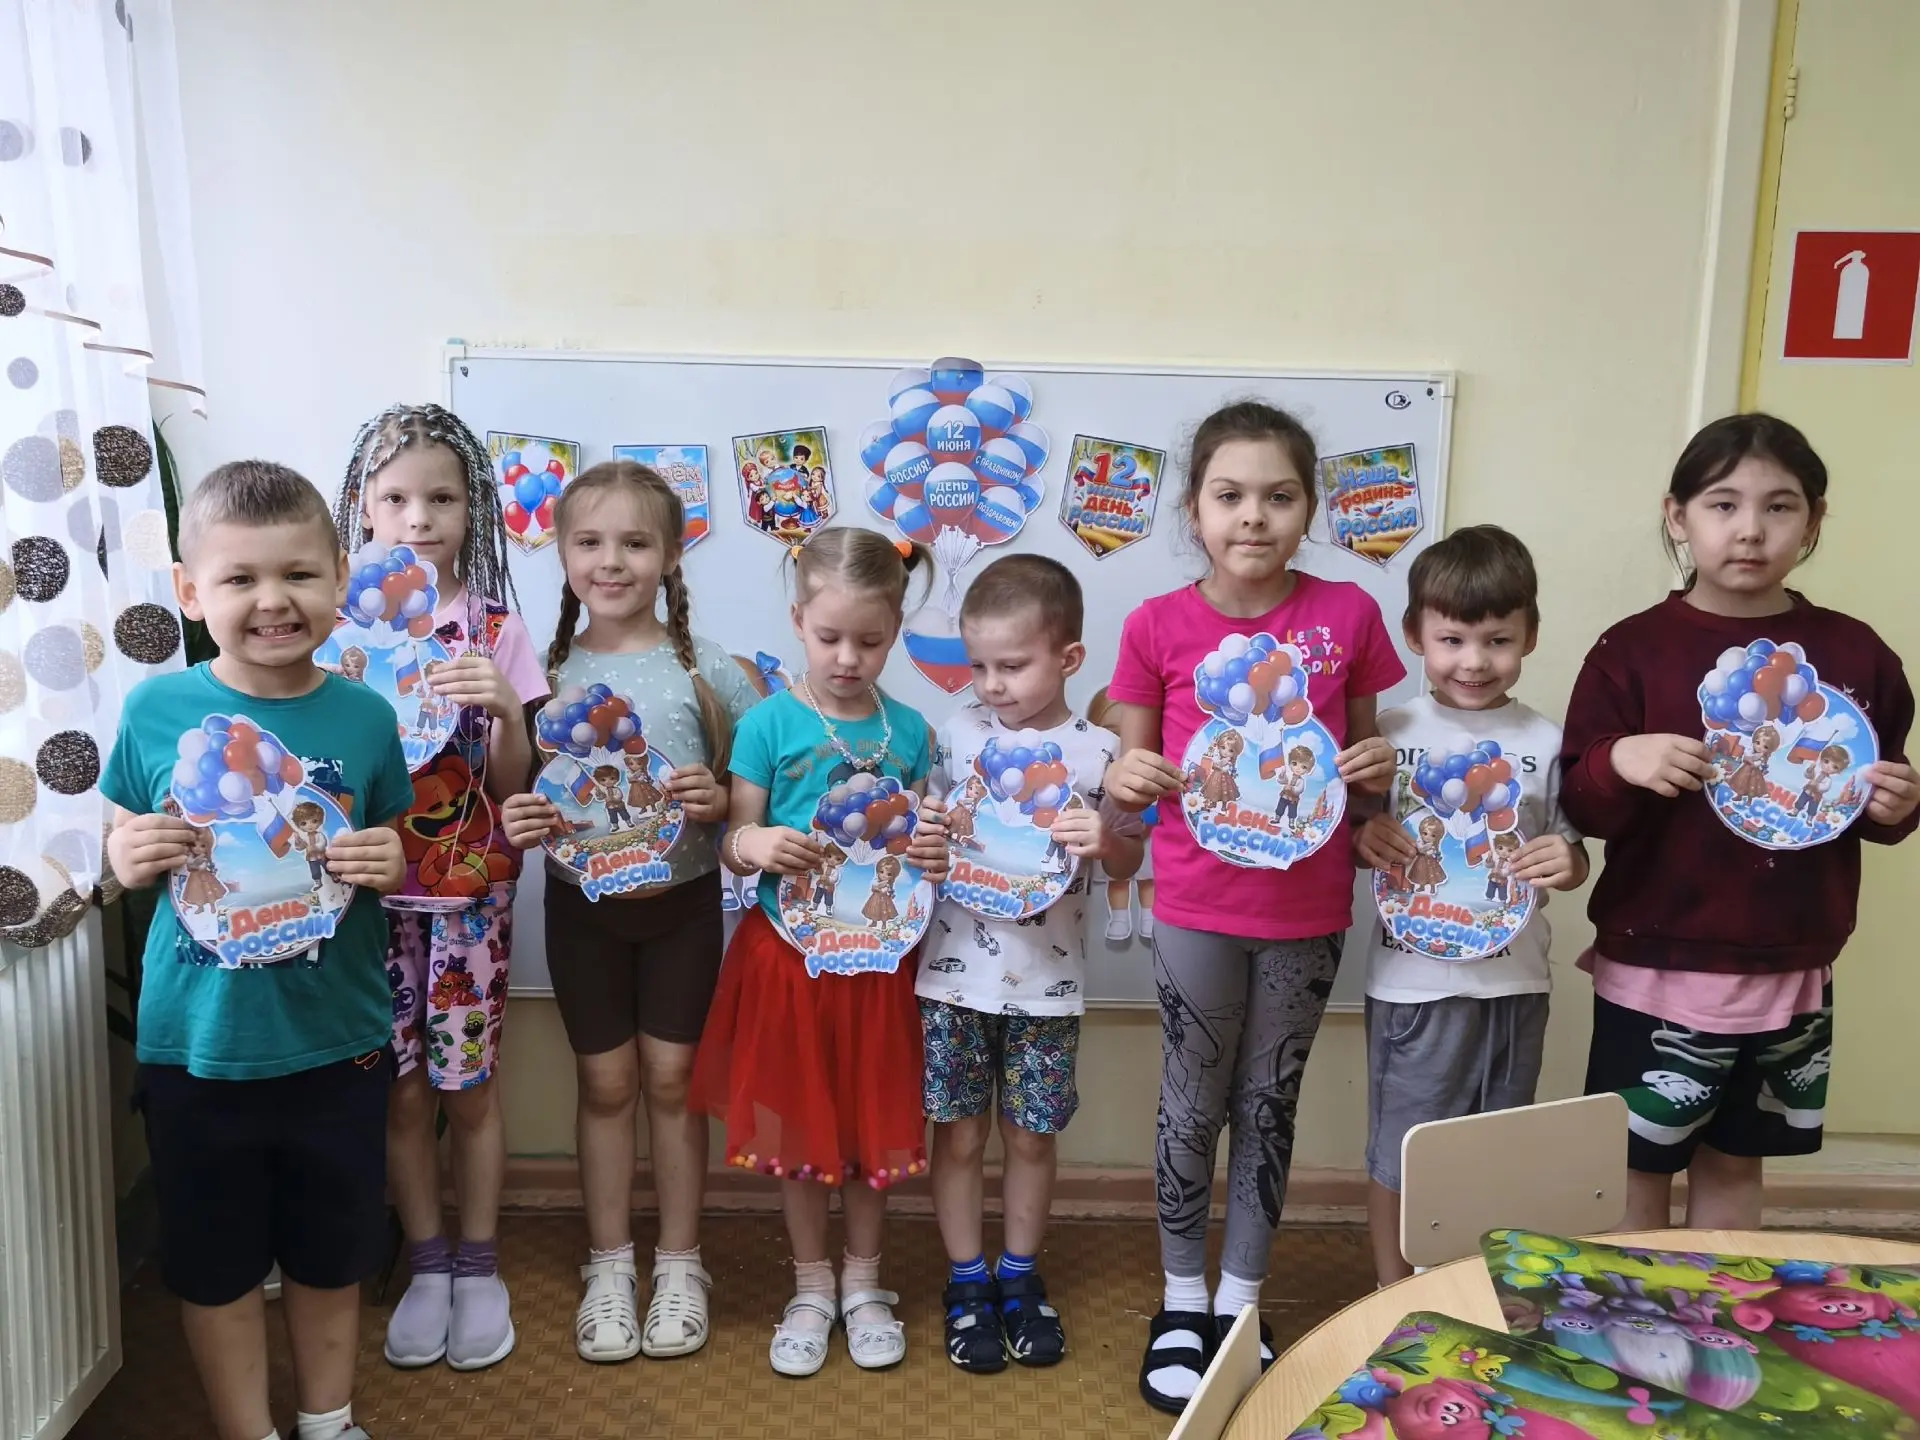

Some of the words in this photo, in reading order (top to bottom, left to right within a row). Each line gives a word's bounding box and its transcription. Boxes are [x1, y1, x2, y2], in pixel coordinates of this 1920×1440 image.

[943, 420, 965, 440] 12
[936, 439, 971, 452] ИЮНЯ
[889, 457, 932, 484] РОССИЯ!
[1092, 452, 1138, 489] 12
[935, 481, 969, 494] ДЕНЬ
[929, 492, 976, 507] РОССИИ
[1082, 495, 1134, 517] ДЕНЬ
